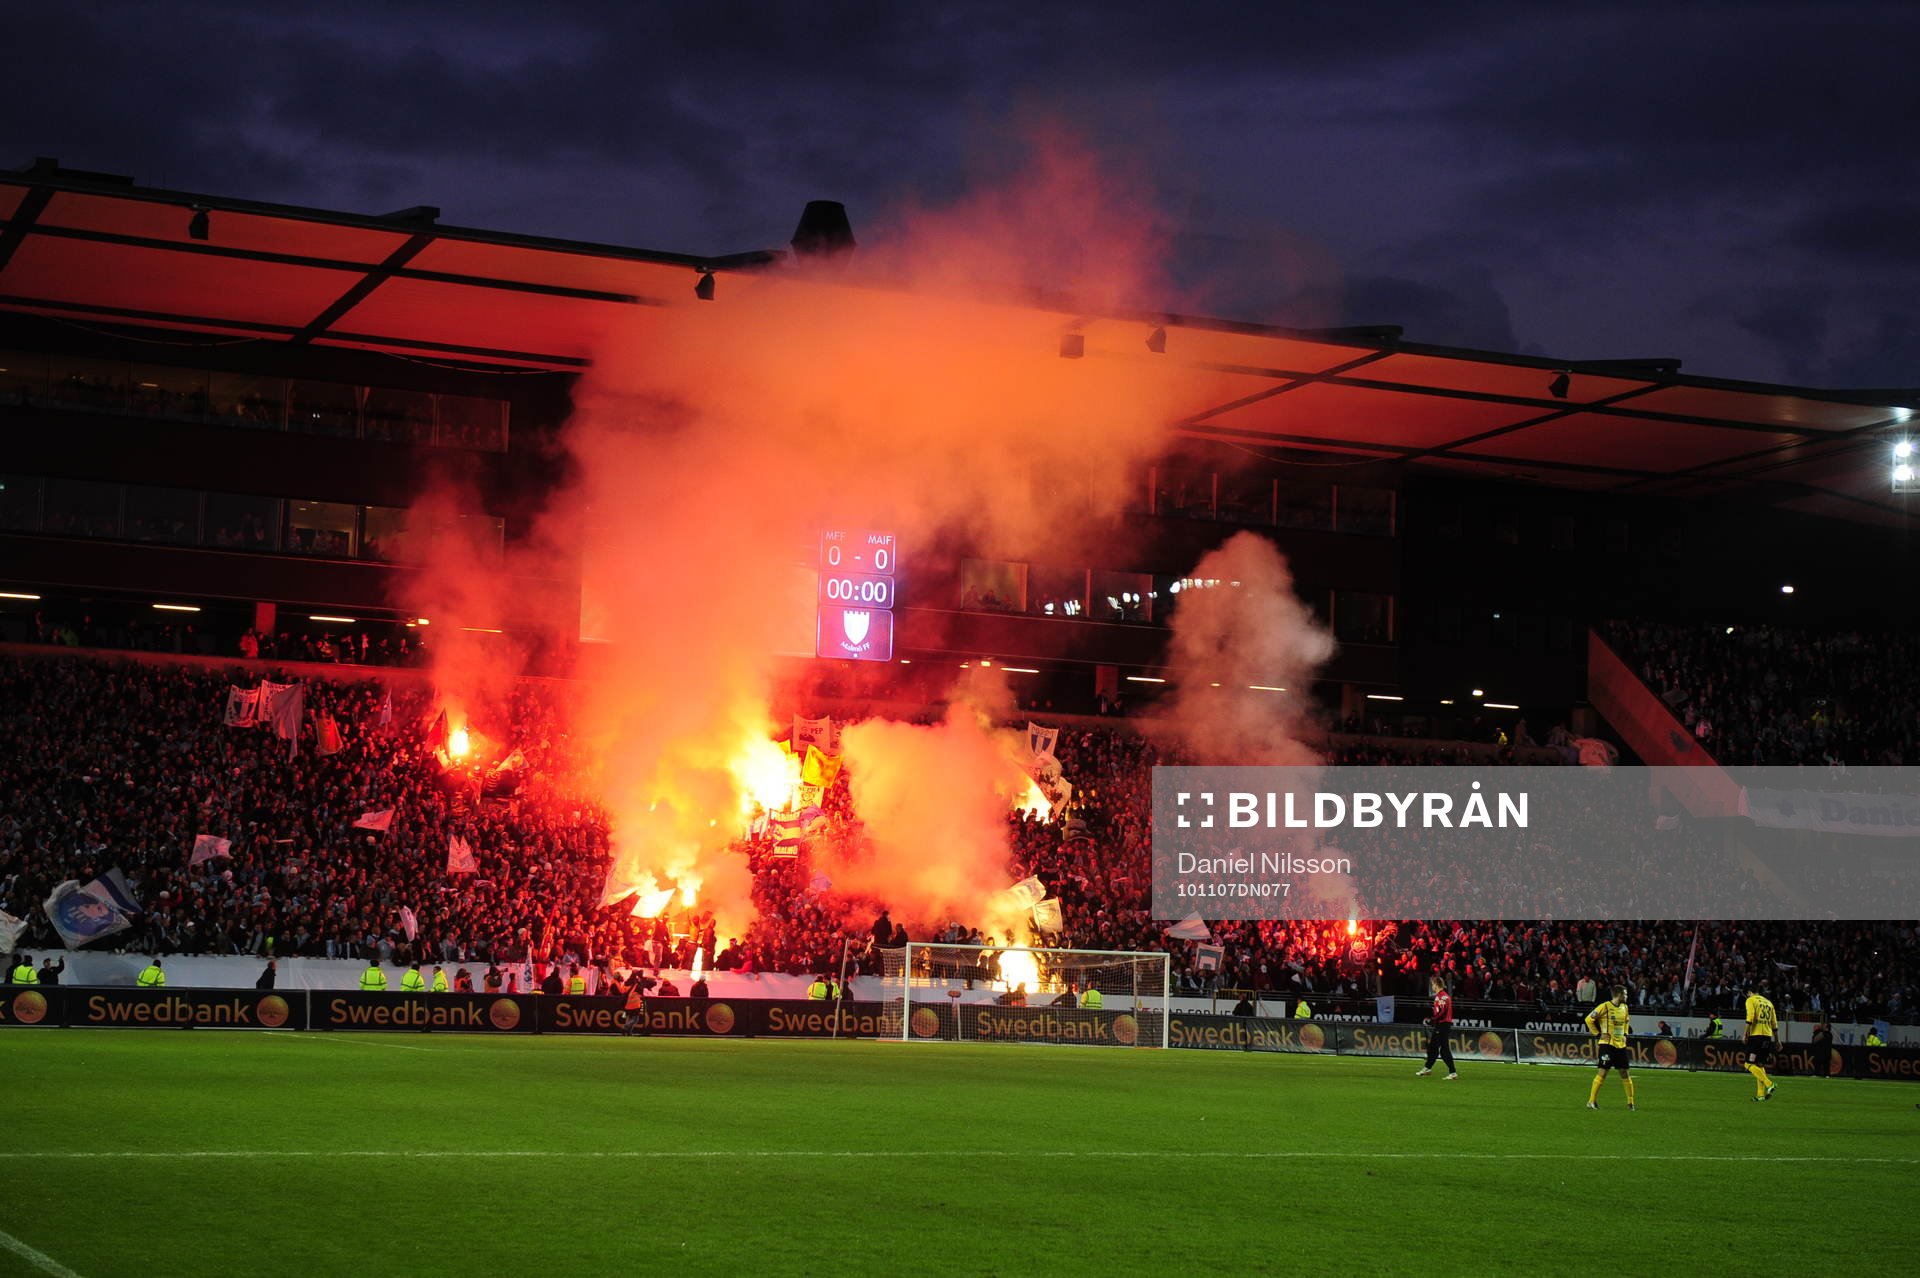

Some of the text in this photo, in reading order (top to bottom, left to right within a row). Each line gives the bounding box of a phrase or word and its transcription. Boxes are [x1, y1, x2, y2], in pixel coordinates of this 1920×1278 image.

[868, 535, 892, 545] MAIF
[828, 546, 840, 565] 0
[875, 549, 888, 569] 0
[827, 579, 887, 603] 00:00
[88, 995, 250, 1024] Swedbank
[330, 998, 484, 1026] Swedbank
[769, 1007, 905, 1034] Swedbank
[1760, 1003, 1771, 1020] 33
[977, 1010, 1108, 1041] Swedbank
[1169, 1019, 1294, 1048] Swedbank
[1353, 1028, 1476, 1055] Swedbnk
[1533, 1036, 1650, 1064] Swednk
[1704, 1044, 1815, 1070] Sweank
